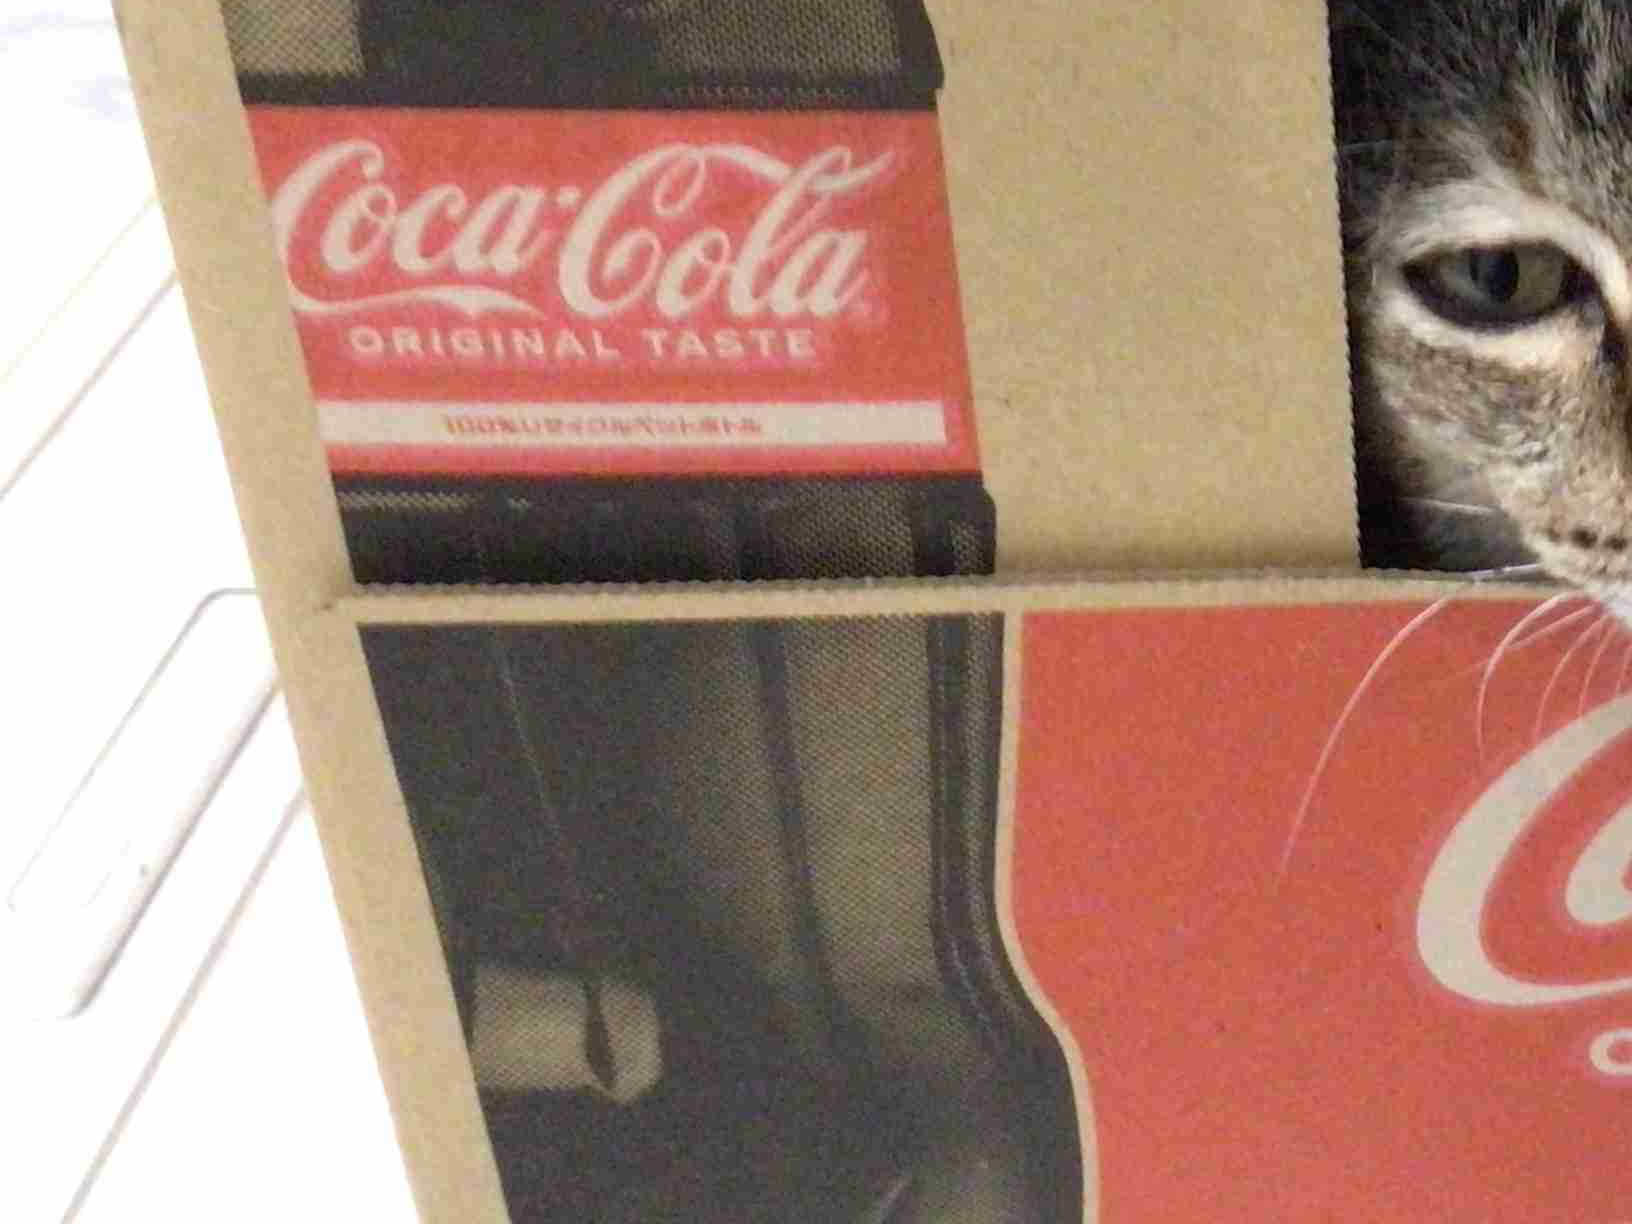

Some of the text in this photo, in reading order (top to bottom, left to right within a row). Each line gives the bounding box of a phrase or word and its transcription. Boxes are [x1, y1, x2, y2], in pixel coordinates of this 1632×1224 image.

[268, 139, 896, 321] Coca-Cola
[349, 325, 817, 362] ORIGINAL TASTE
